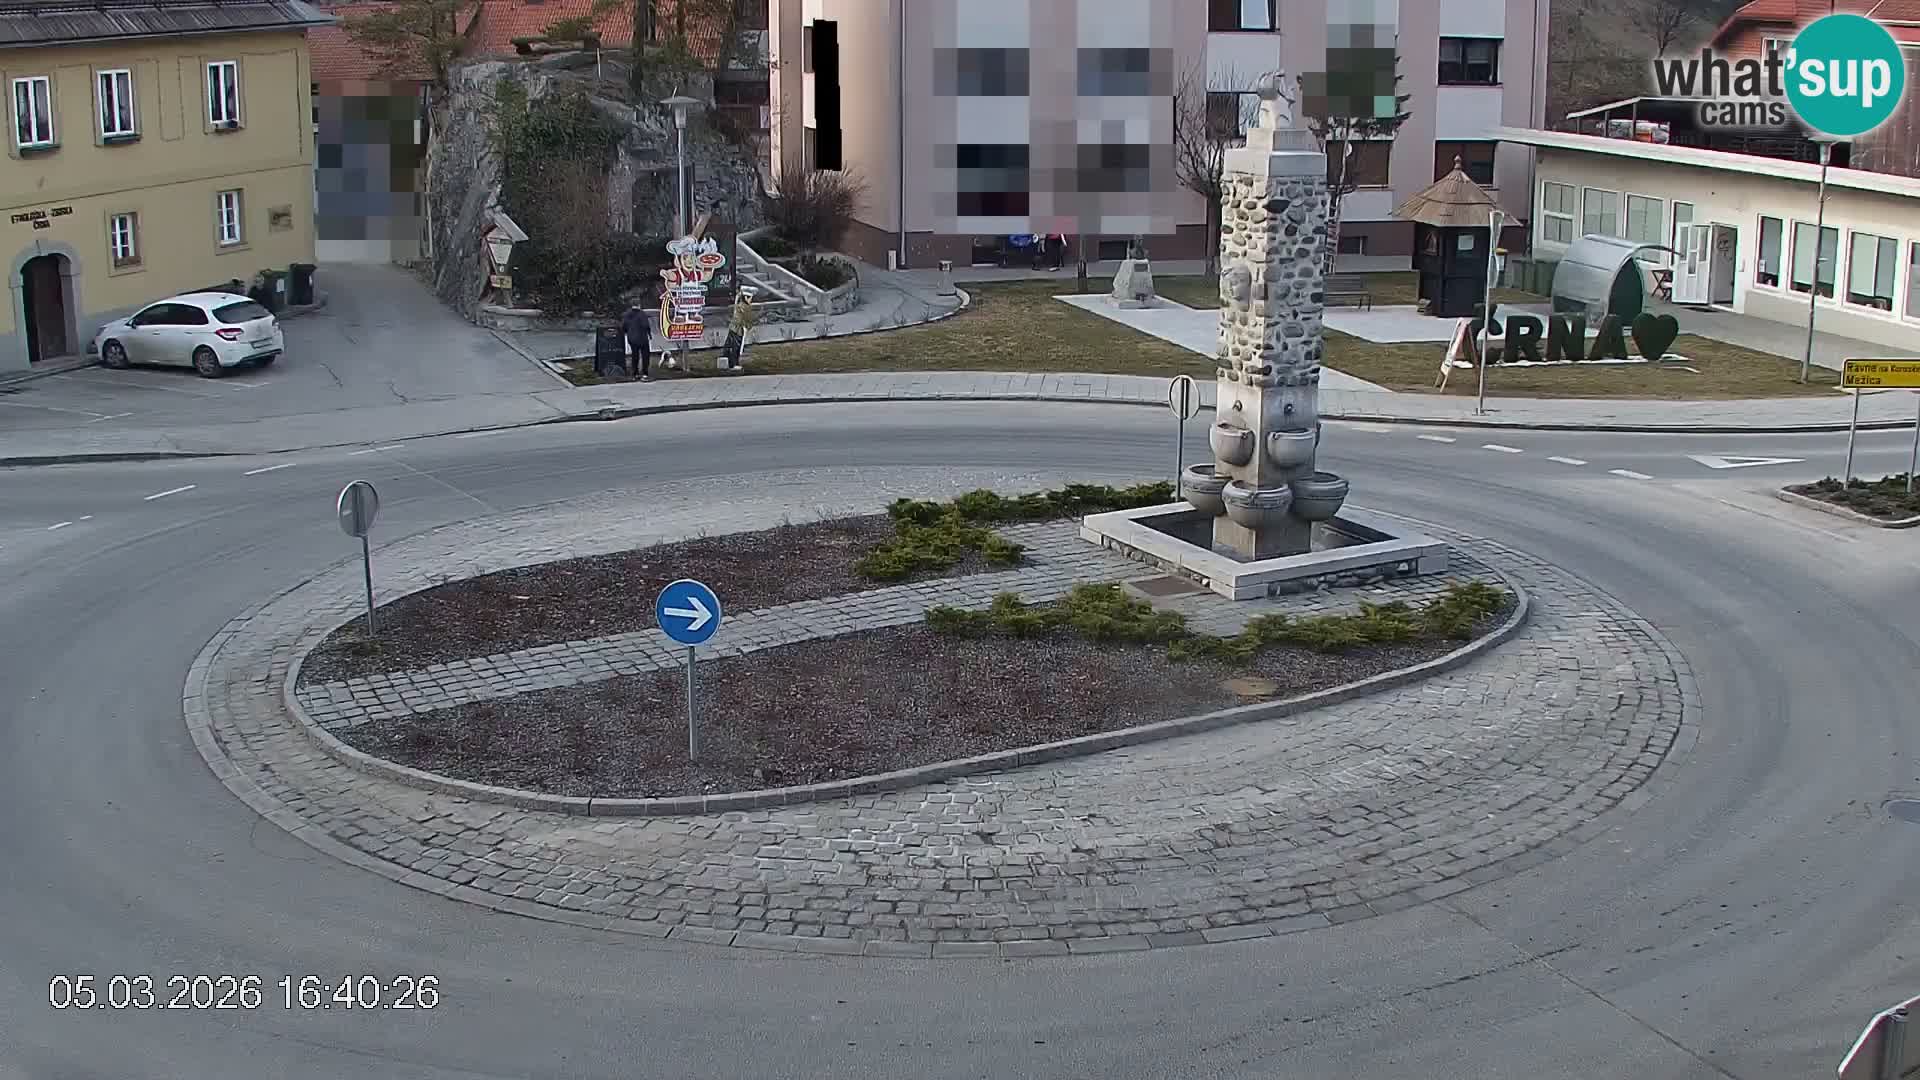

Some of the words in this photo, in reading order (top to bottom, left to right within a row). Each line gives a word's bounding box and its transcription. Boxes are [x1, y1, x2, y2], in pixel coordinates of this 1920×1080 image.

[1469, 302, 1629, 365] ČRNA
[1846, 362, 1877, 373] Ravne
[1845, 374, 1881, 385] Mežica
